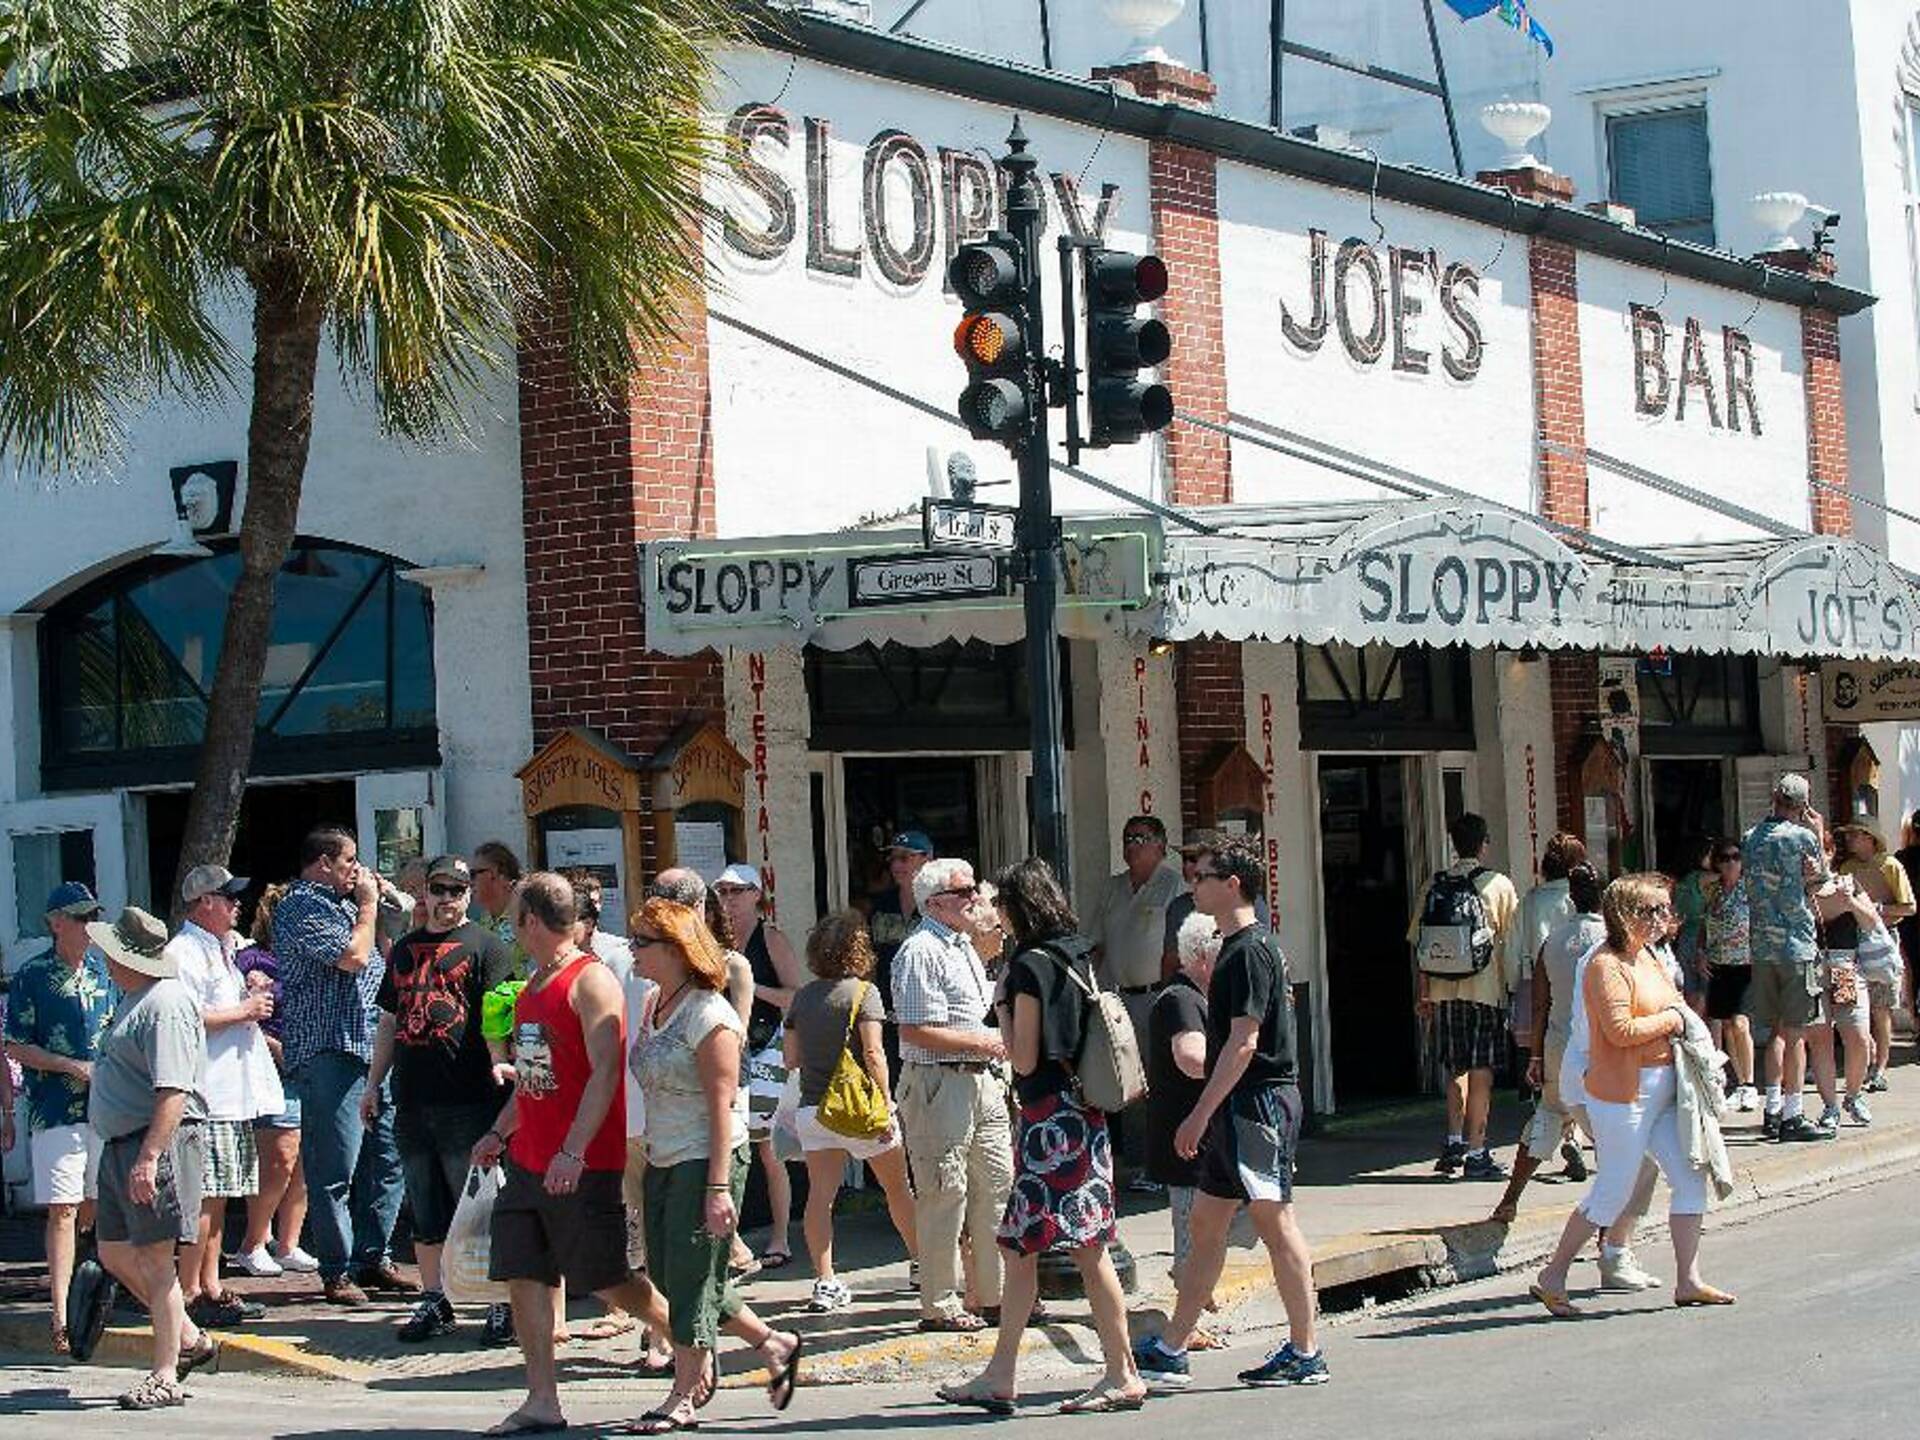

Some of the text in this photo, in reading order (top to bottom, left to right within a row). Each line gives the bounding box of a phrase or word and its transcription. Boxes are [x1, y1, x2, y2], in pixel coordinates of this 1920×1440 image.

[1280, 228, 1483, 382] JOE'S
[1629, 302, 1762, 437] BAR
[666, 558, 834, 613] SLOPPY
[878, 563, 973, 591] Greene St
[1358, 550, 1572, 626] SLOPPY
[1797, 590, 1902, 651] JOE'S
[528, 755, 621, 807] SLOPPY JOE'S
[1268, 840, 1280, 935] BEER
